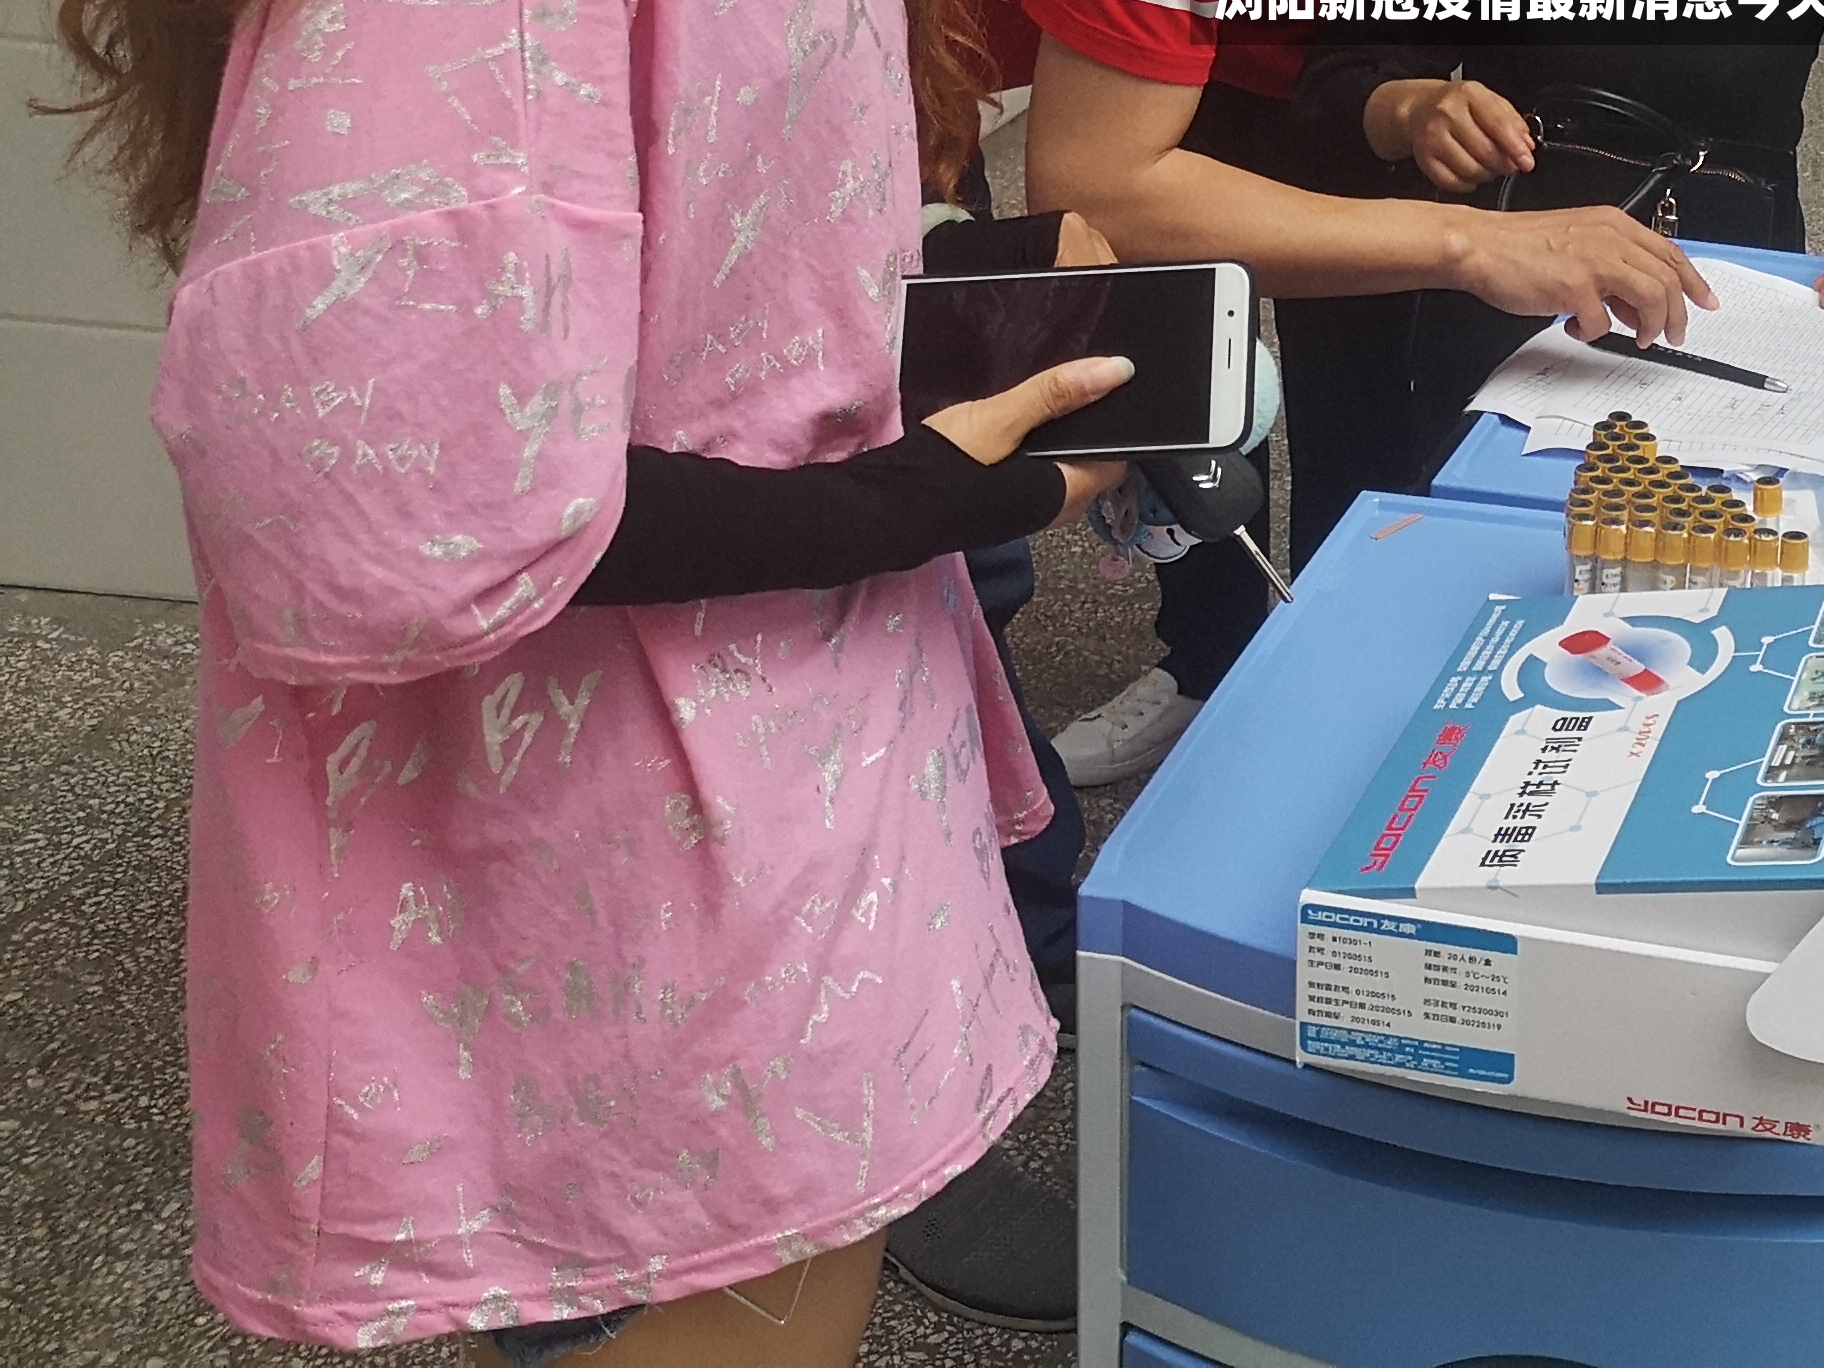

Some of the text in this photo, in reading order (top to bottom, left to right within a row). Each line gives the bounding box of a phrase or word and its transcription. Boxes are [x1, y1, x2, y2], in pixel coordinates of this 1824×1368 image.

[1421, 722, 1471, 771] 友康
[1479, 715, 1594, 868] 病毒采样试剂盒
[1380, 919, 1417, 936] 友康
[1751, 1116, 1814, 1142] 友康
